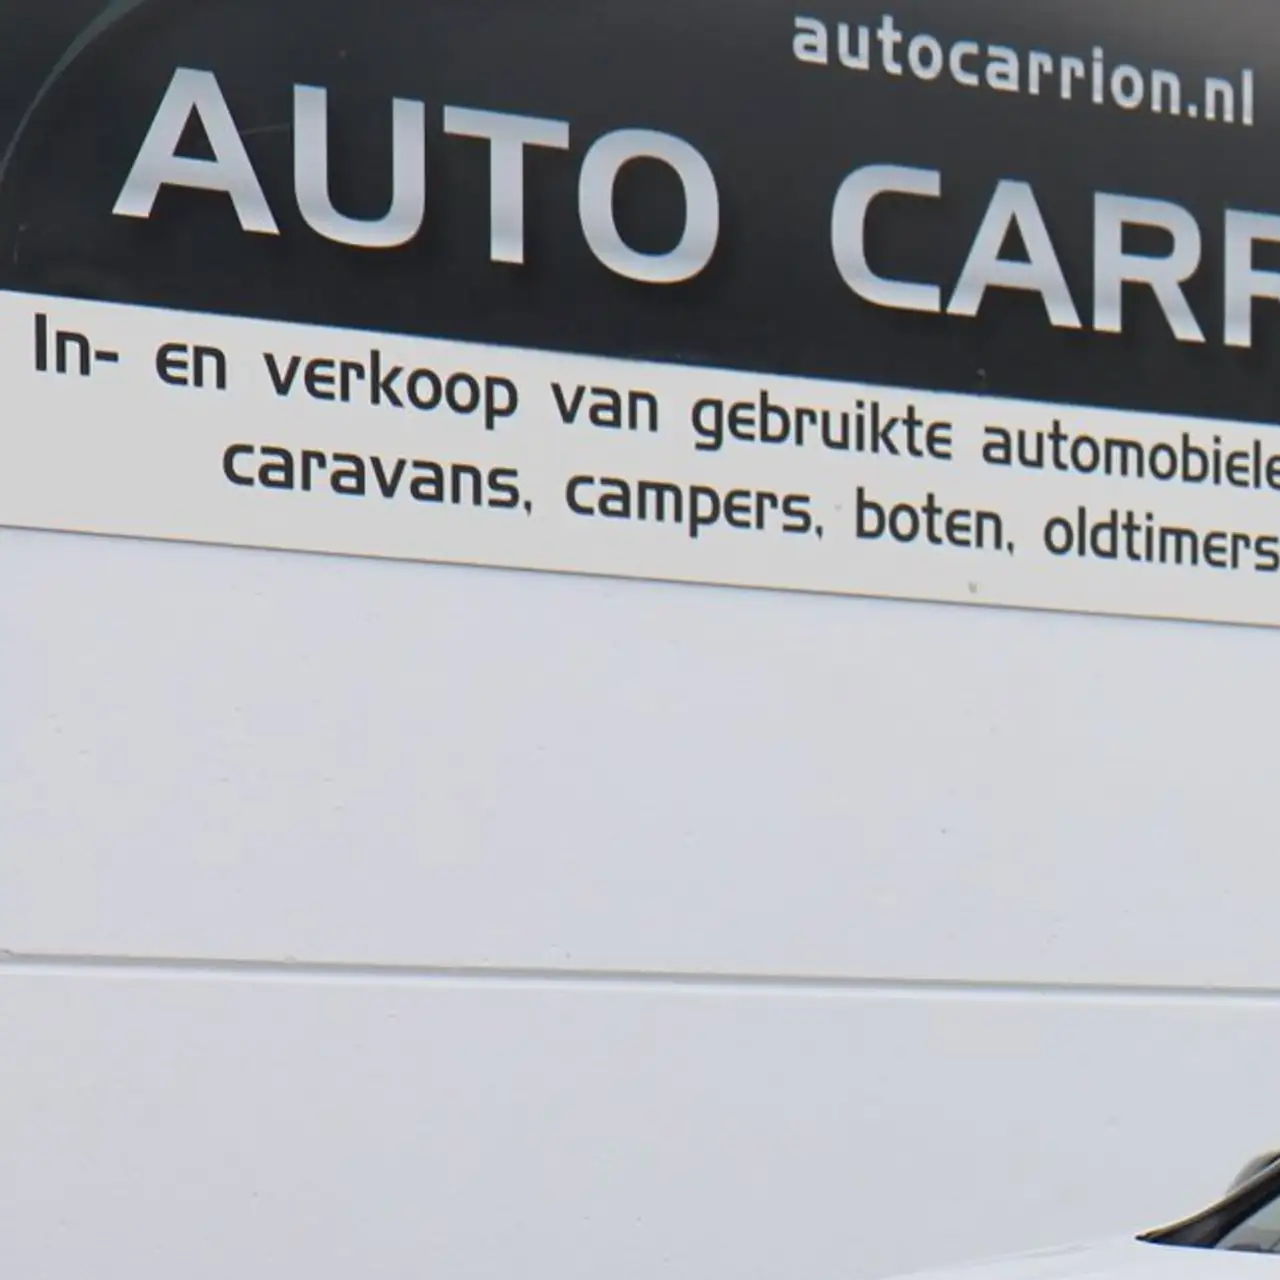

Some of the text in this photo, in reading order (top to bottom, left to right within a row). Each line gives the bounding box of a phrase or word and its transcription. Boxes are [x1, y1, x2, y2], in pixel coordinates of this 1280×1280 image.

[792, 15, 1255, 126] autocarrion.nl
[111, 67, 720, 284] AUTO
[34, 312, 119, 376] In-
[155, 342, 227, 390] en
[263, 349, 518, 431] verkoop
[550, 382, 658, 433] van
[691, 389, 952, 461] gebruikte
[223, 443, 533, 515] caravans,
[565, 475, 824, 539] campers,
[1044, 506, 1280, 572] oldtimers
